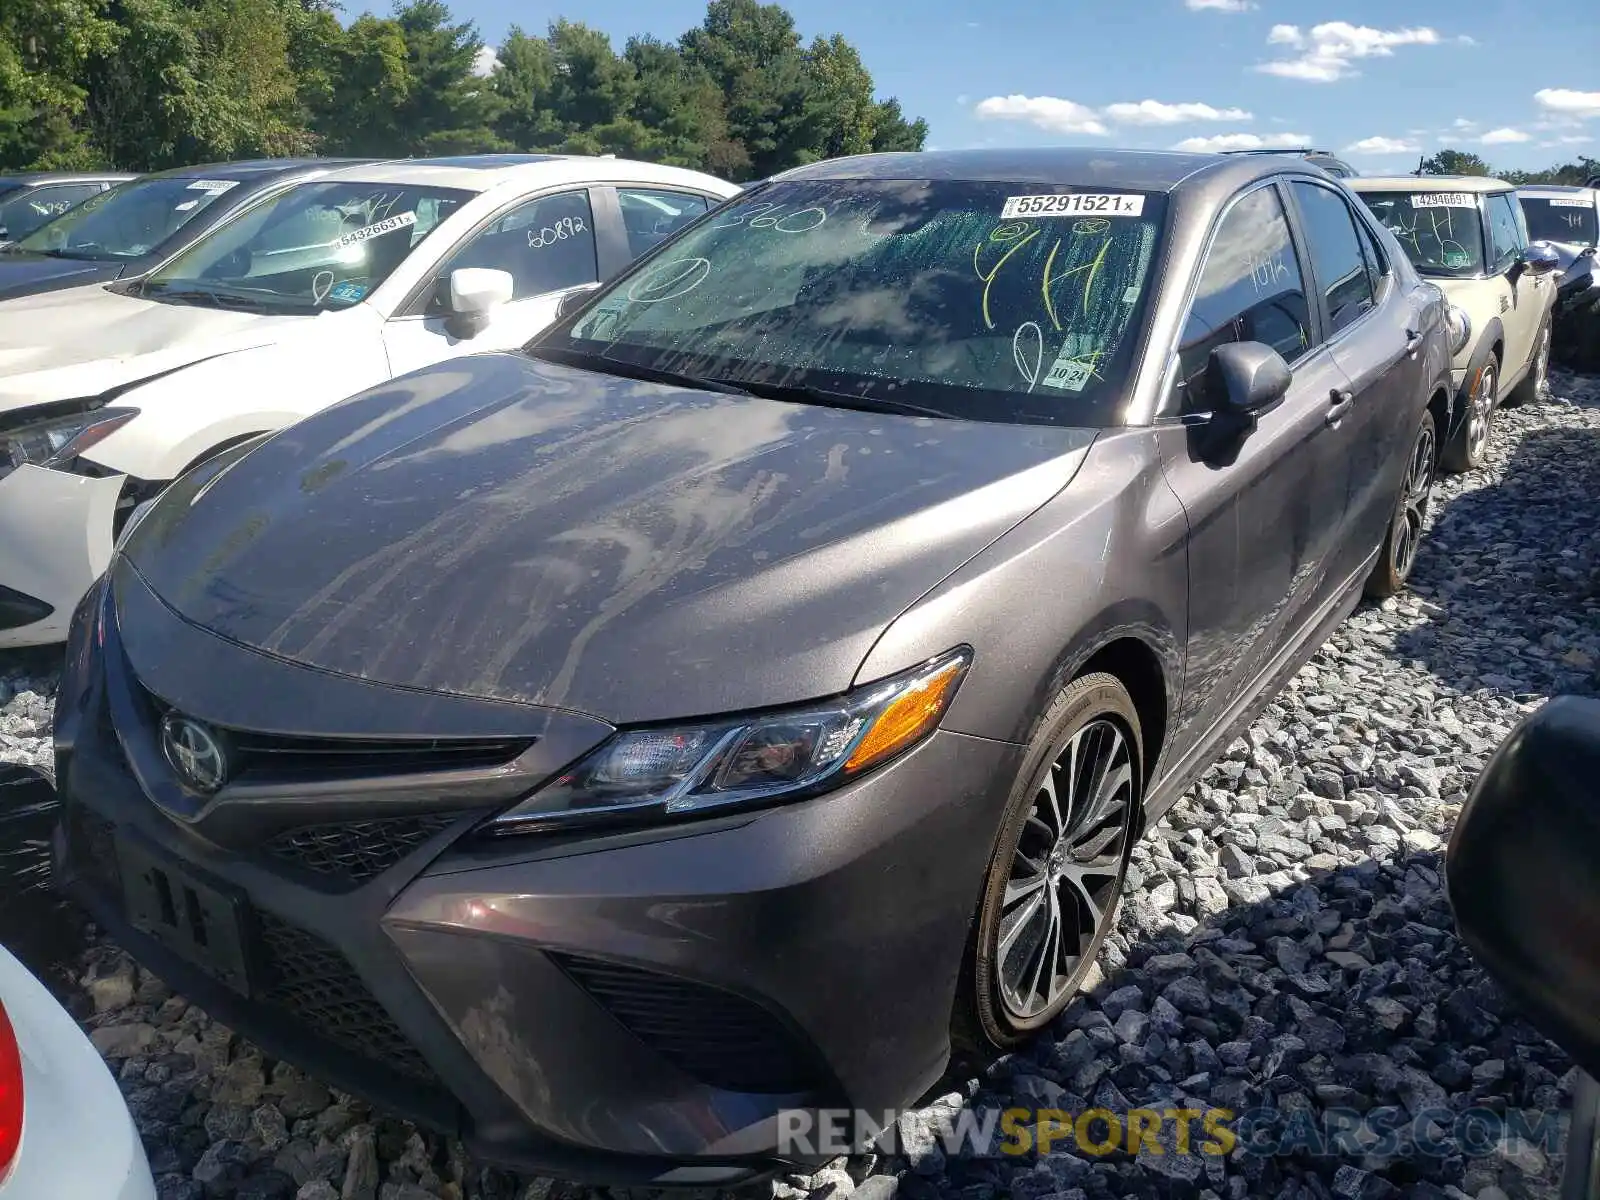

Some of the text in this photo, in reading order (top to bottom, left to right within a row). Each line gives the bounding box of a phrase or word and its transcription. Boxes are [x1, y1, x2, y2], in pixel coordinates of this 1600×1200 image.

[527, 216, 588, 248] 60892
[1053, 366, 1086, 382] 10 24
